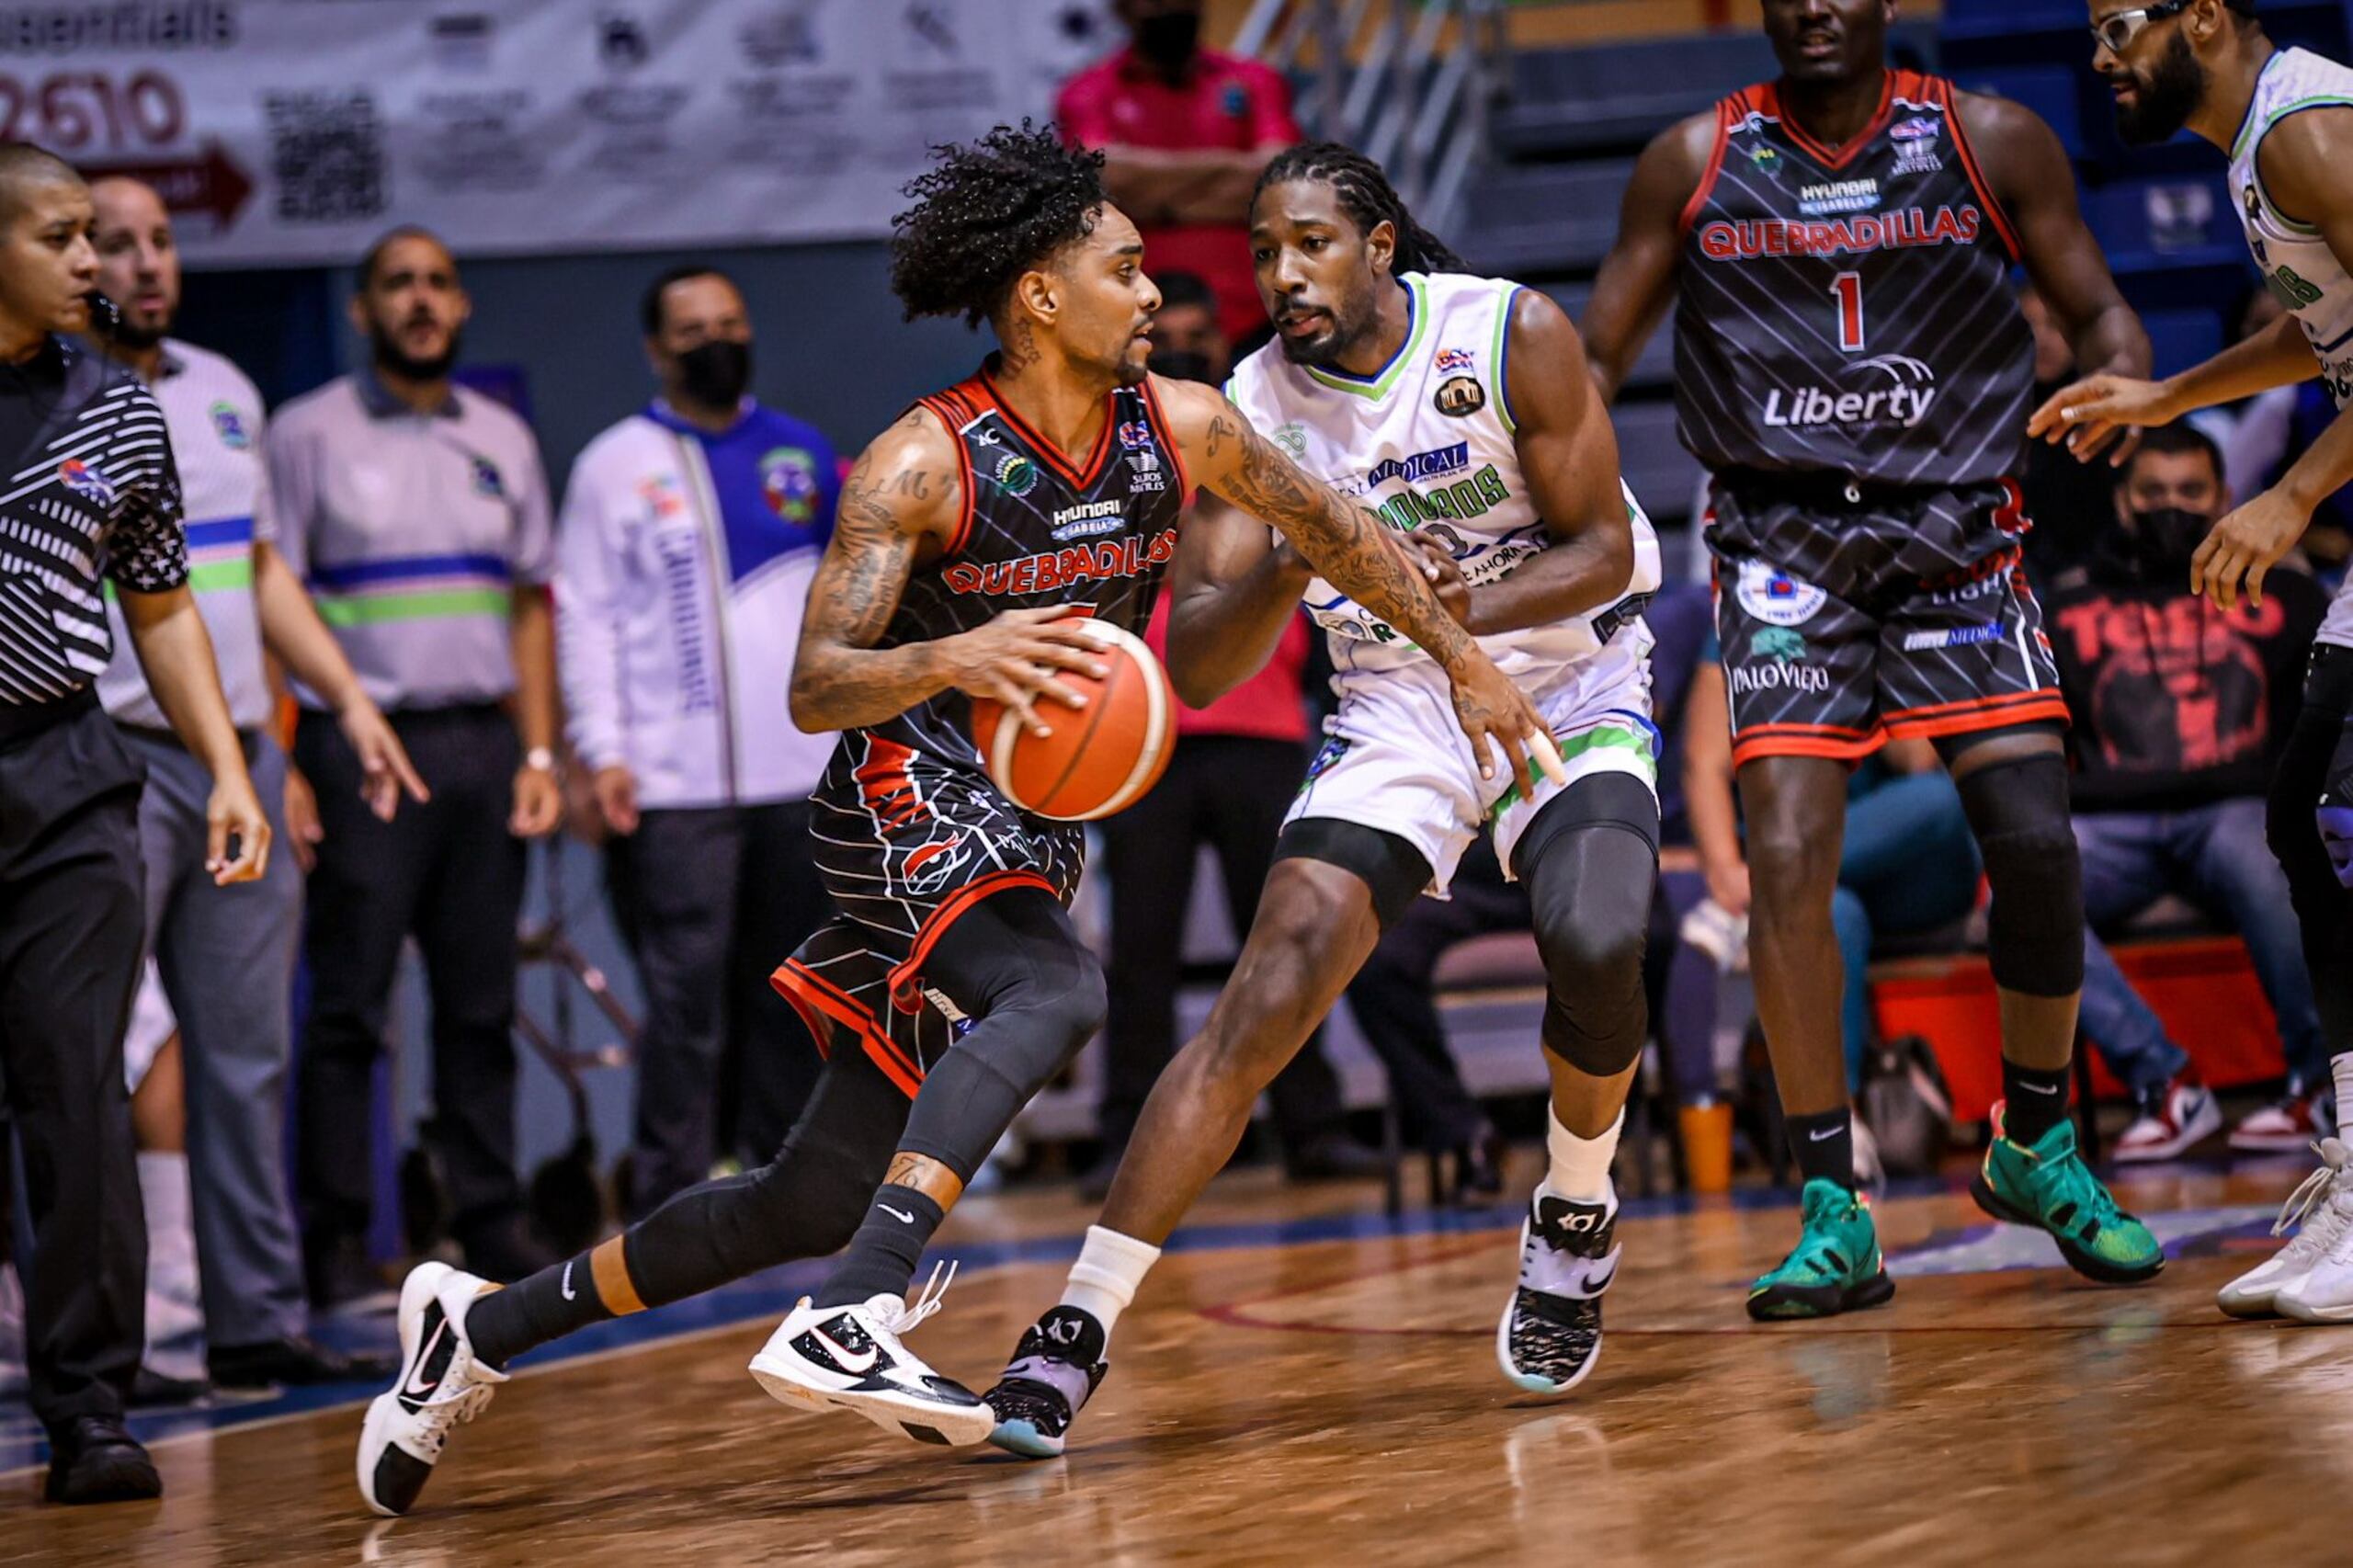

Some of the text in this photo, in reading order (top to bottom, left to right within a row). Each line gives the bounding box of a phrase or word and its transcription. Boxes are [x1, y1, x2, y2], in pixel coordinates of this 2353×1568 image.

[1801, 178, 1877, 200] HYUNDAI
[1699, 204, 1981, 261] QUEBRADILLAS
[1829, 271, 1865, 352] 1
[1764, 382, 1936, 427] Liberty
[1370, 447, 1466, 485] MEDICAL
